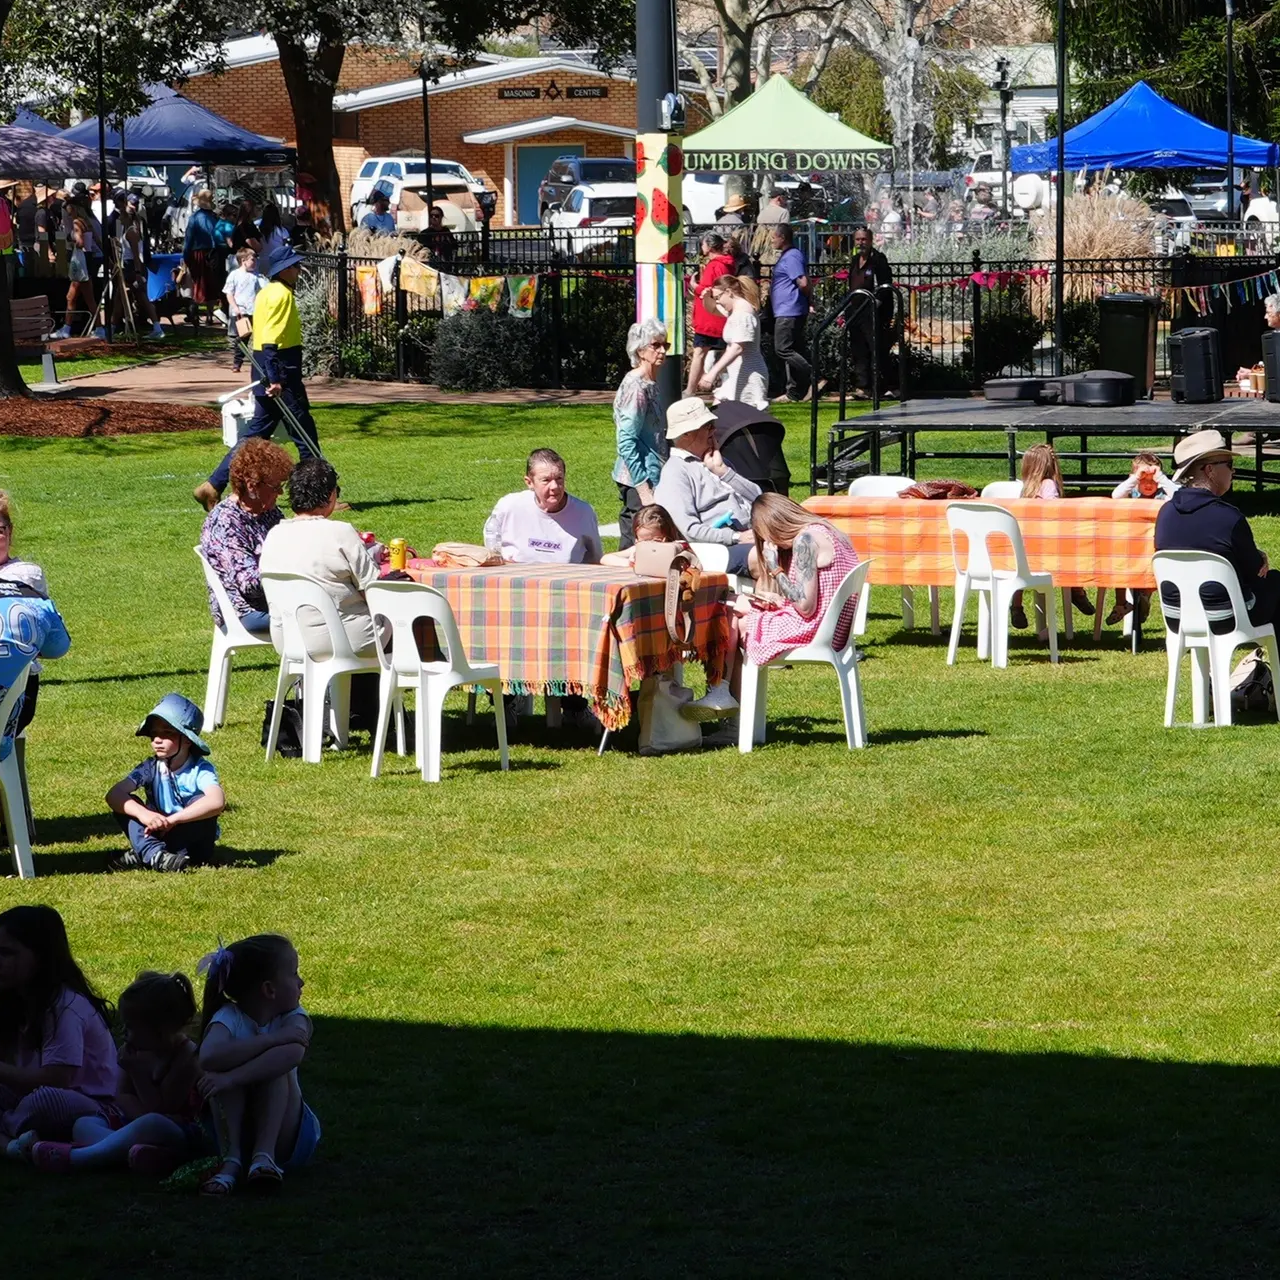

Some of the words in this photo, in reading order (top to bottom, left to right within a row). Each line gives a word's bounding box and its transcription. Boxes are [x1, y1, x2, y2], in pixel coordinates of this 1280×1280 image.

[503, 89, 536, 97] MASONIC
[573, 88, 601, 97] CENTRE
[683, 152, 788, 171] UMBLING
[795, 152, 881, 170] DOWNS
